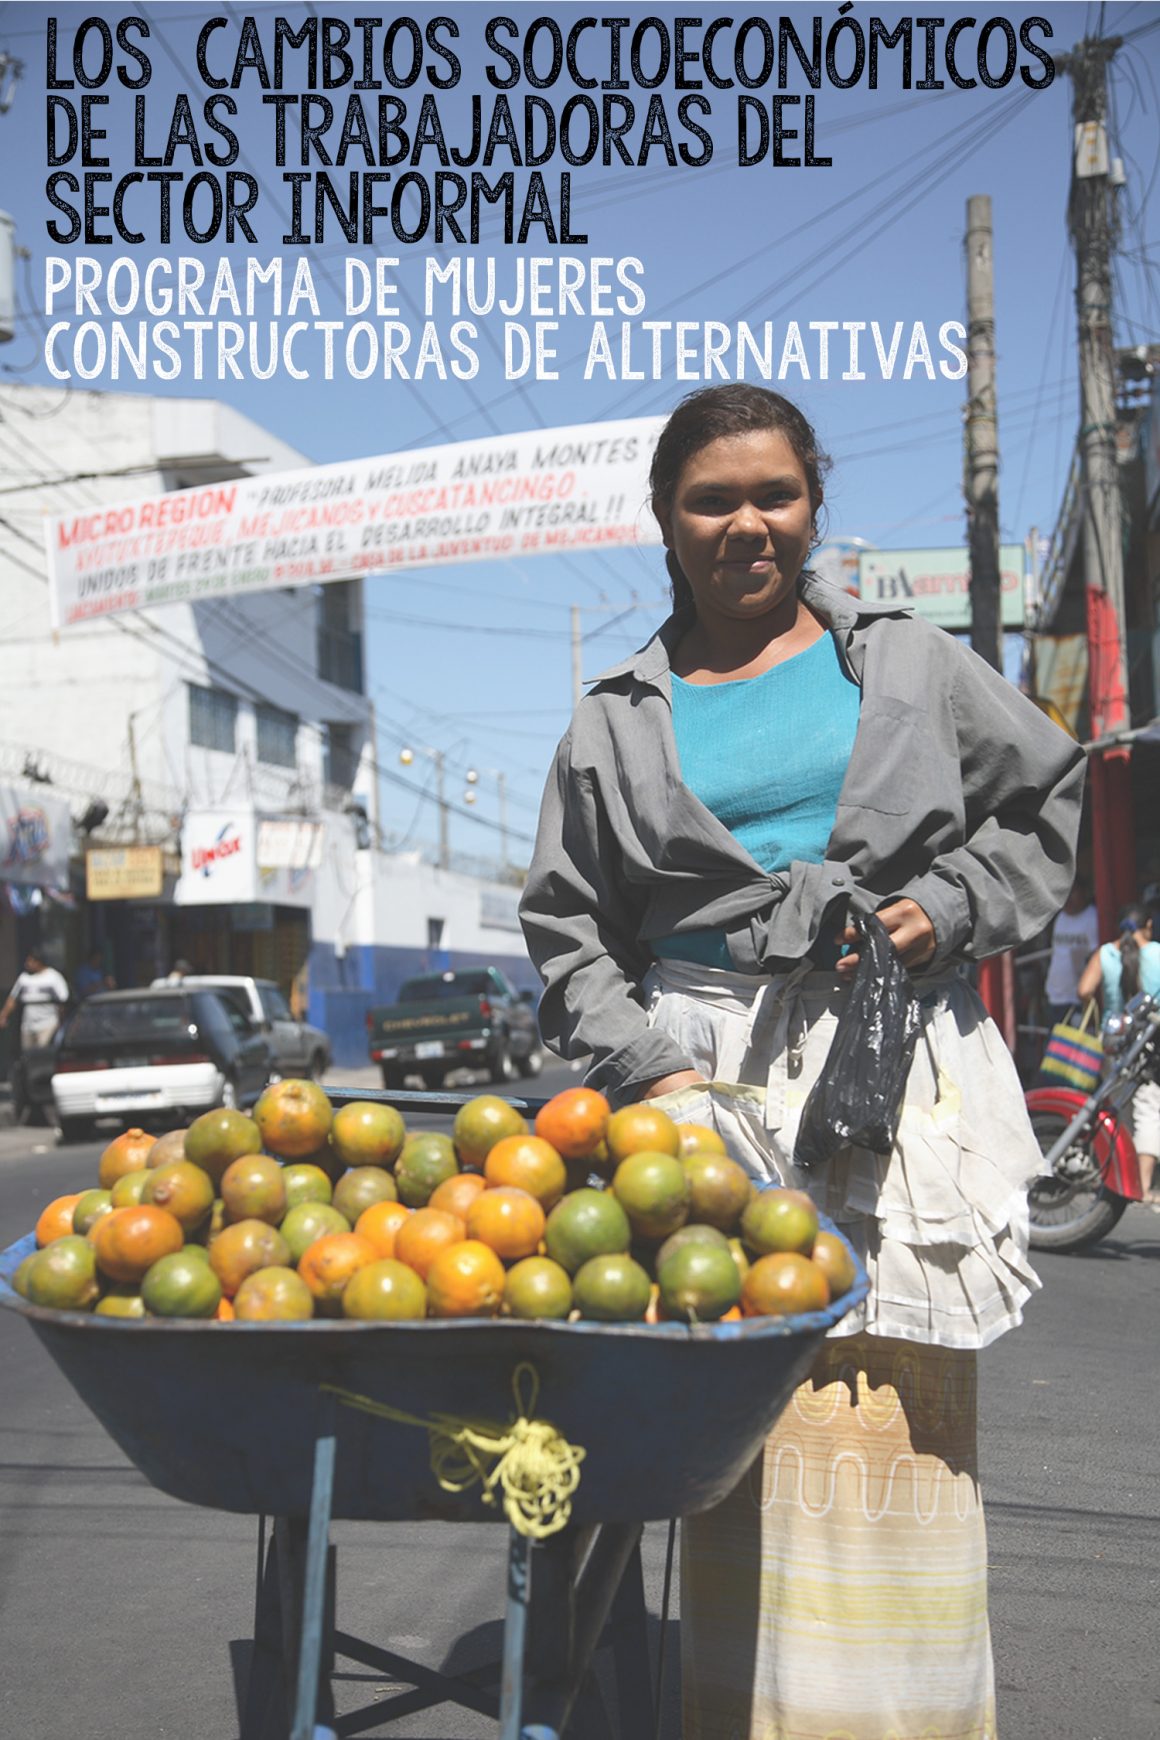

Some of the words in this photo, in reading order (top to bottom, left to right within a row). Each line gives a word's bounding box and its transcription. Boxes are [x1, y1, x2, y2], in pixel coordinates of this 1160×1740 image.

[58, 506, 135, 550] MICRO
[138, 487, 237, 530] REGION
[451, 450, 518, 479] ANAYA
[78, 562, 137, 598] UNIDOS
[147, 559, 166, 581] DE
[175, 540, 257, 577] FRENTE
[263, 533, 318, 561] HACIA
[326, 530, 347, 553] EL
[361, 513, 489, 548] DESARROLLO
